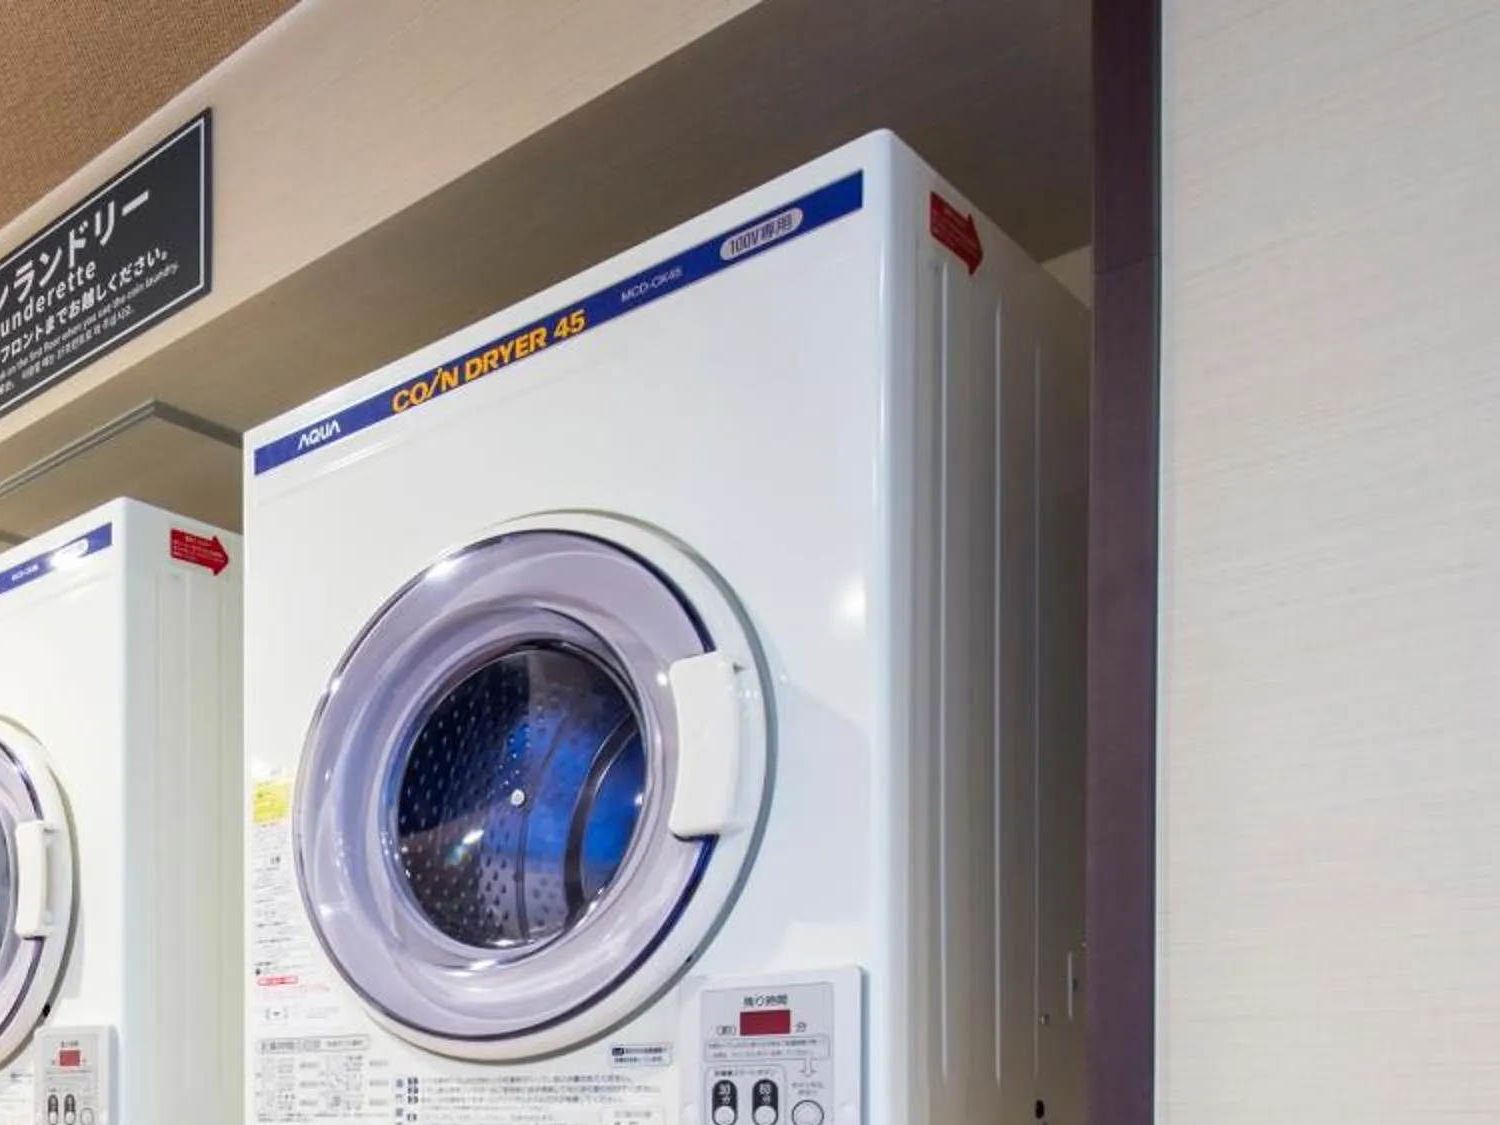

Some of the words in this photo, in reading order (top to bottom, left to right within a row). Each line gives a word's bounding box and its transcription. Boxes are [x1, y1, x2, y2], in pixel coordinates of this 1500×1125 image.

[298, 419, 341, 450] AQUA
[464, 326, 547, 383] DRYER
[553, 308, 586, 340] 45
